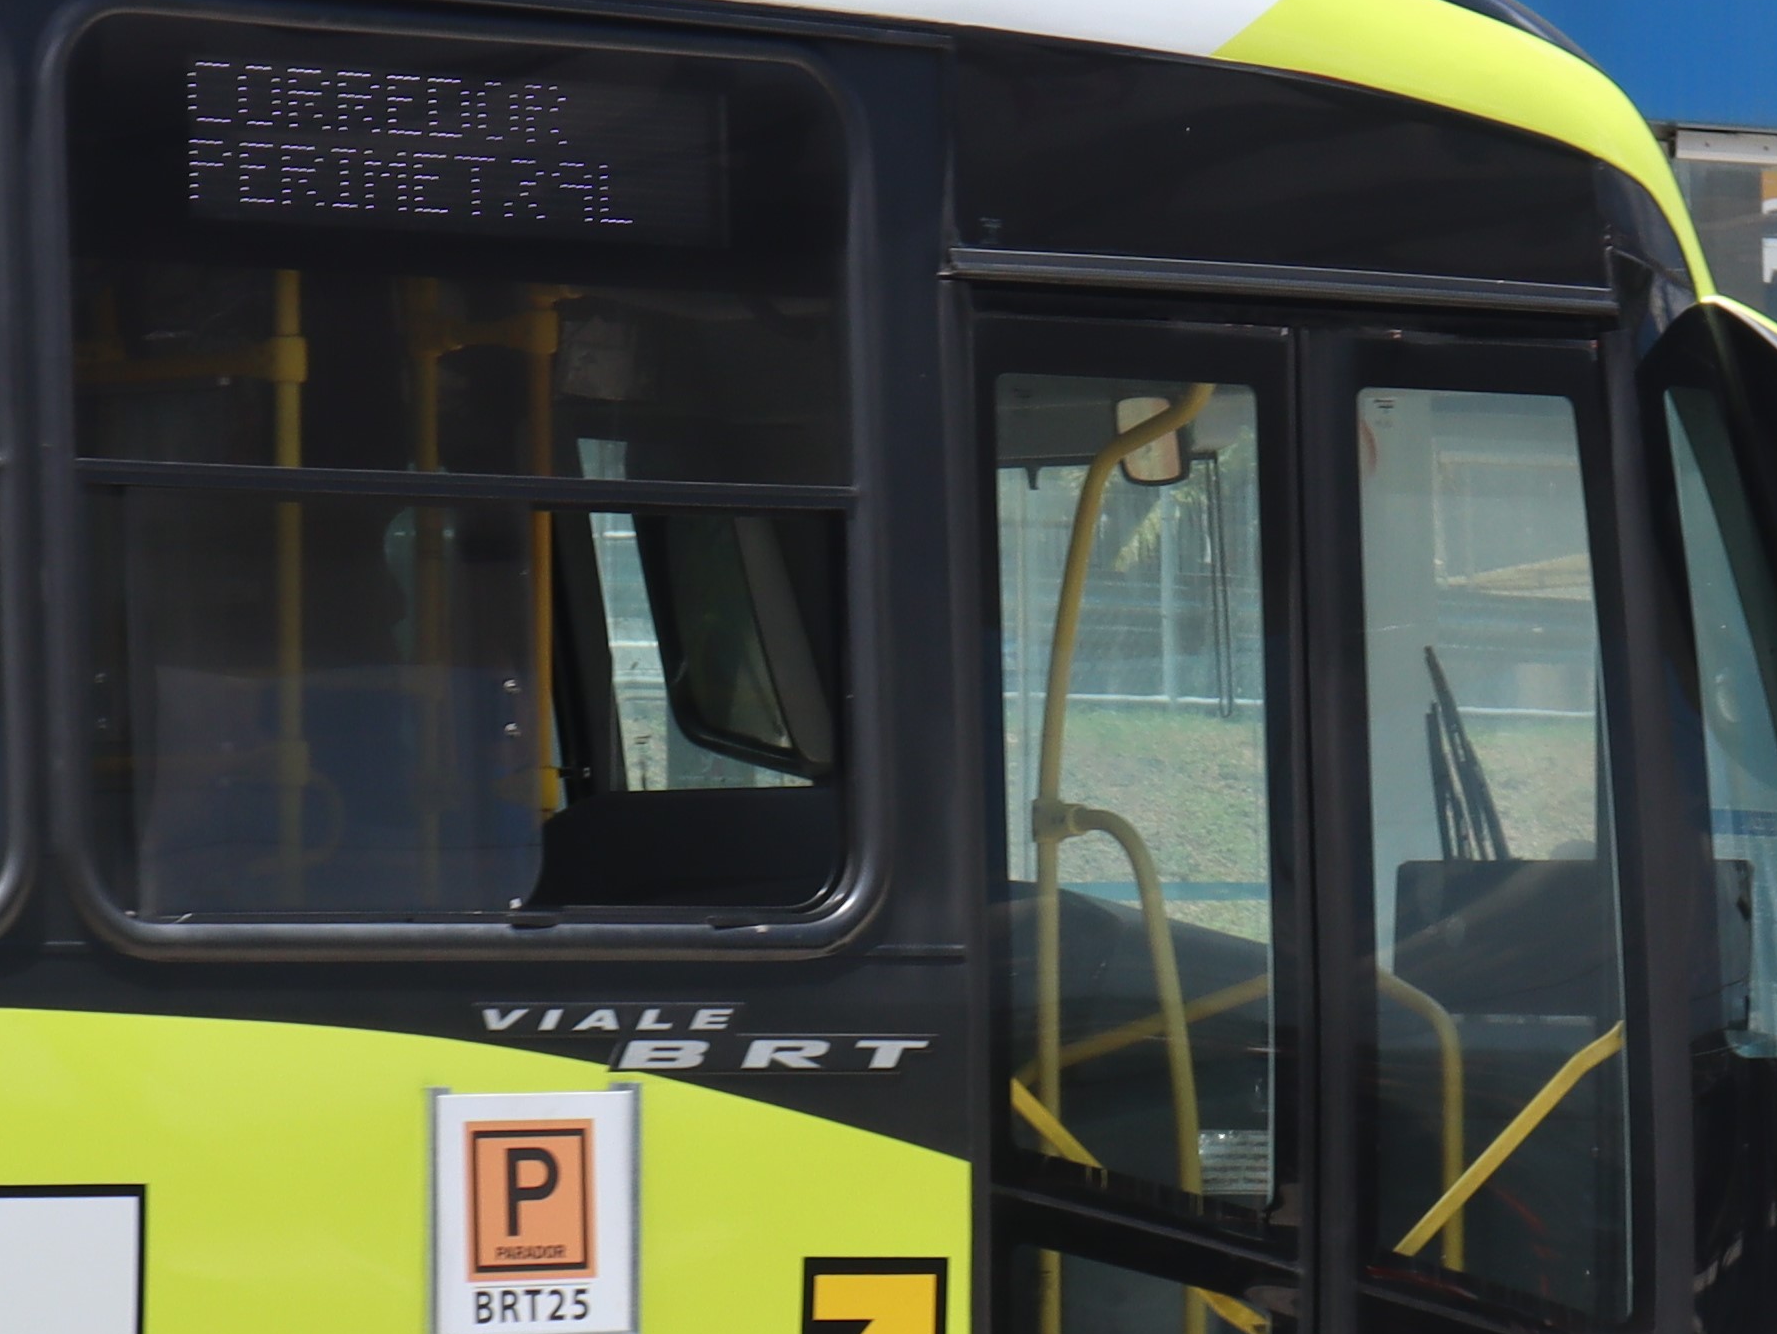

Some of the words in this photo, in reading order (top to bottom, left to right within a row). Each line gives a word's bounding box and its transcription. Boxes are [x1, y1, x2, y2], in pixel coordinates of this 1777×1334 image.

[186, 61, 568, 145] CORREDOR
[188, 139, 634, 225] PERIMETRAL
[482, 1008, 735, 1031] VIALE
[618, 1038, 930, 1070] BRT
[506, 1146, 559, 1237] P
[495, 1245, 566, 1261] PARADOR
[474, 1288, 590, 1324] BRT25
